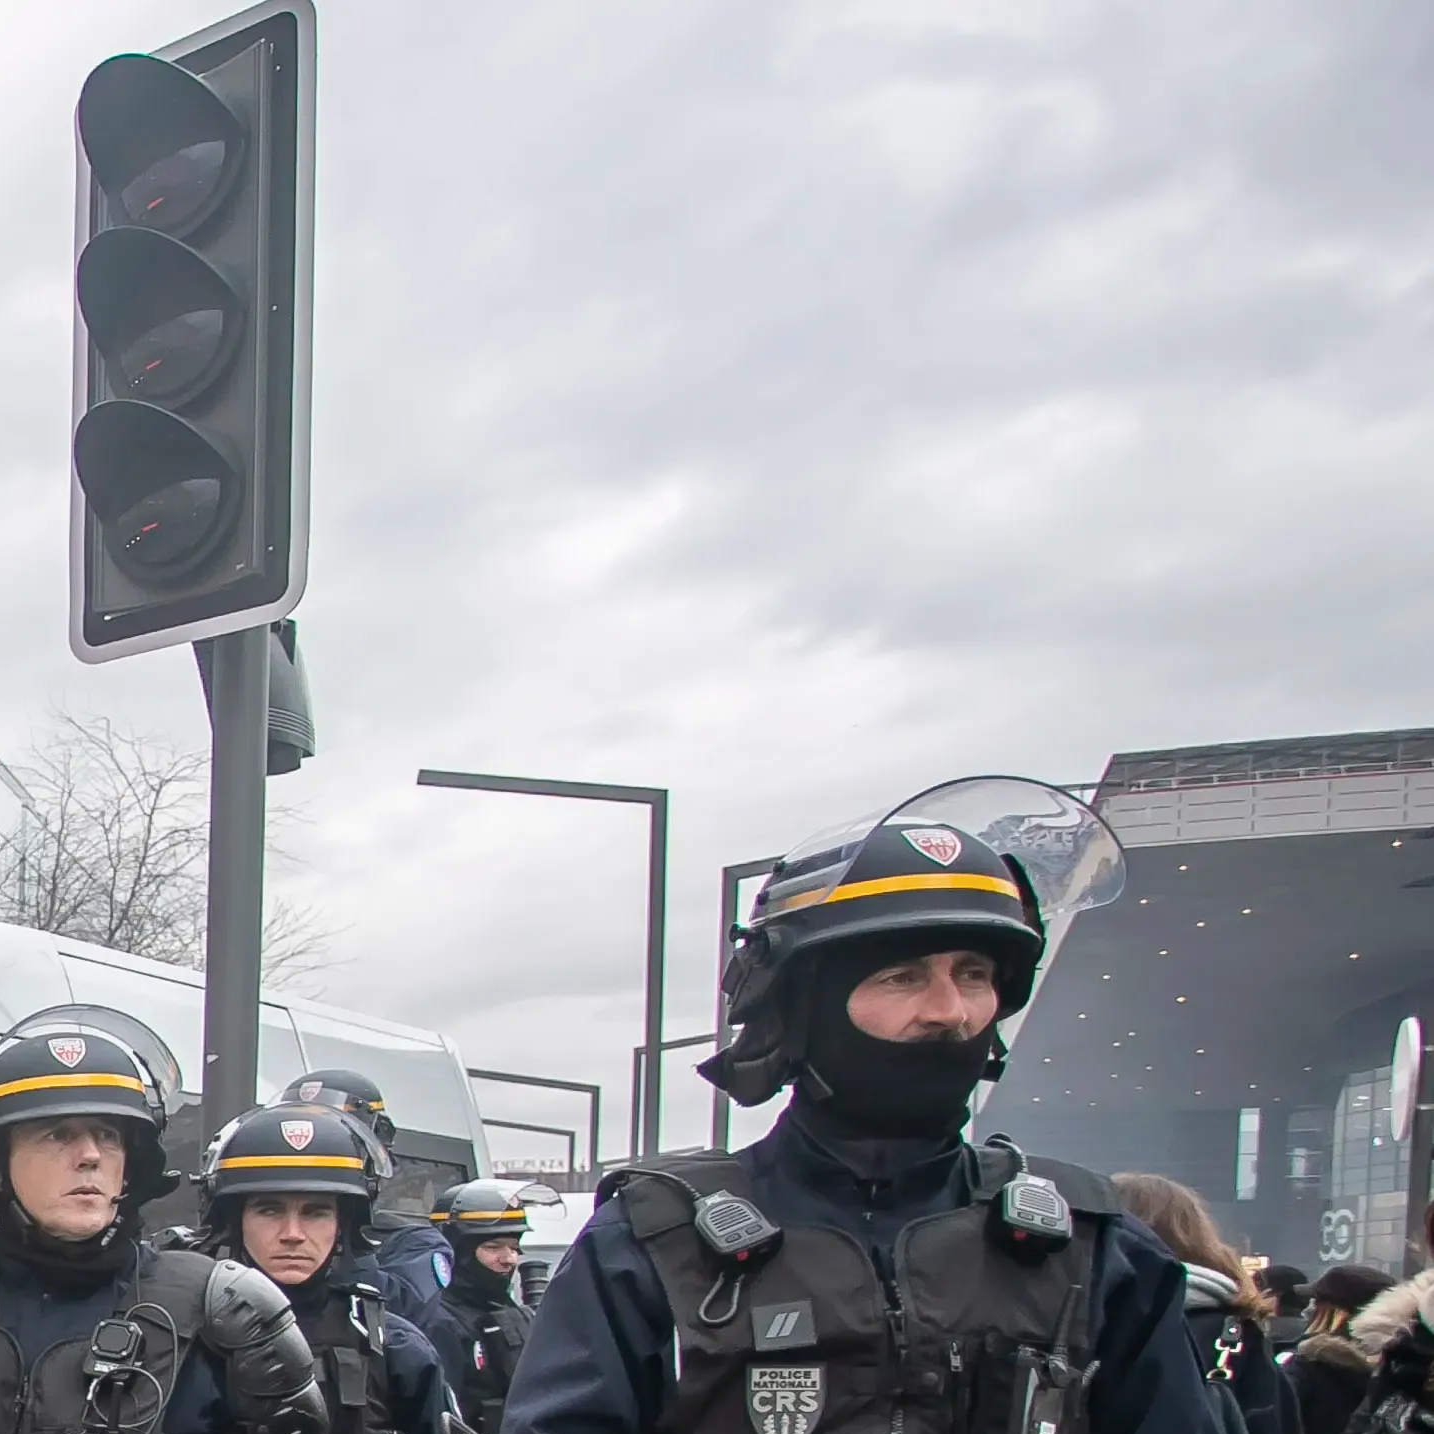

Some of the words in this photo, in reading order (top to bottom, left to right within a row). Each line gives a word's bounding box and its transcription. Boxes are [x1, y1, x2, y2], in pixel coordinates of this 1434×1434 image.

[759, 1370, 812, 1380] POLICE
[753, 1380, 818, 1389] NATIONALE
[753, 1391, 819, 1413] CRS
